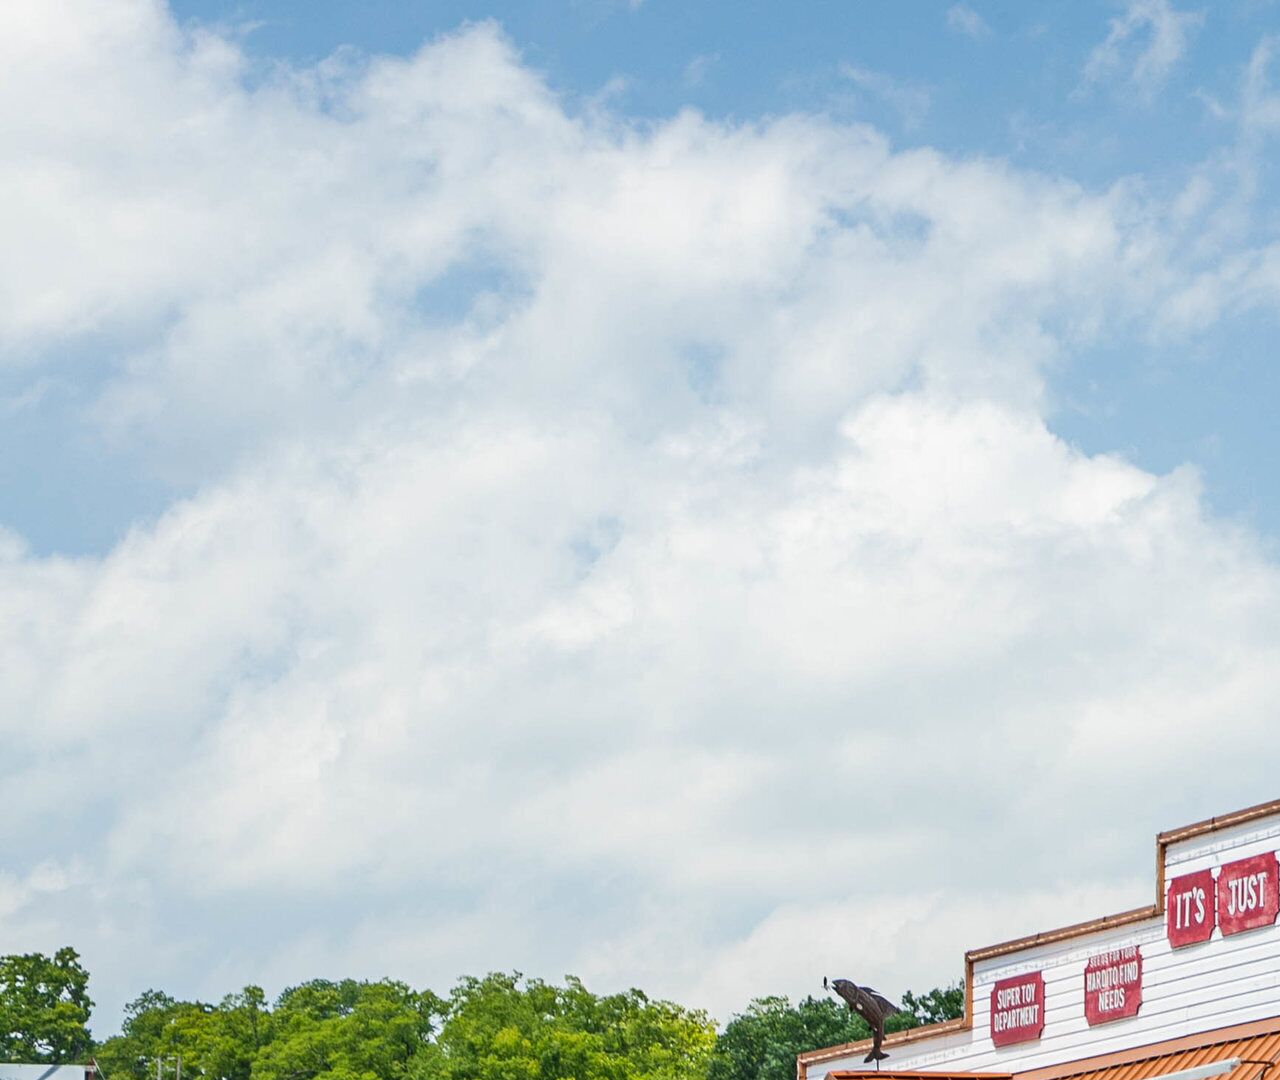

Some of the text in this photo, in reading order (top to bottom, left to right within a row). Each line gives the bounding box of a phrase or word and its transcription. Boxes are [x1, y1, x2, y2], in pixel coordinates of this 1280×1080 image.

[1176, 885, 1206, 930] IT'S
[1227, 872, 1268, 916] JUST
[1119, 960, 1138, 985] FIND
[997, 983, 1036, 1010] SUPER TOY
[1098, 988, 1126, 1013] NEEDS
[994, 1004, 1040, 1032] DEPARTMENT
